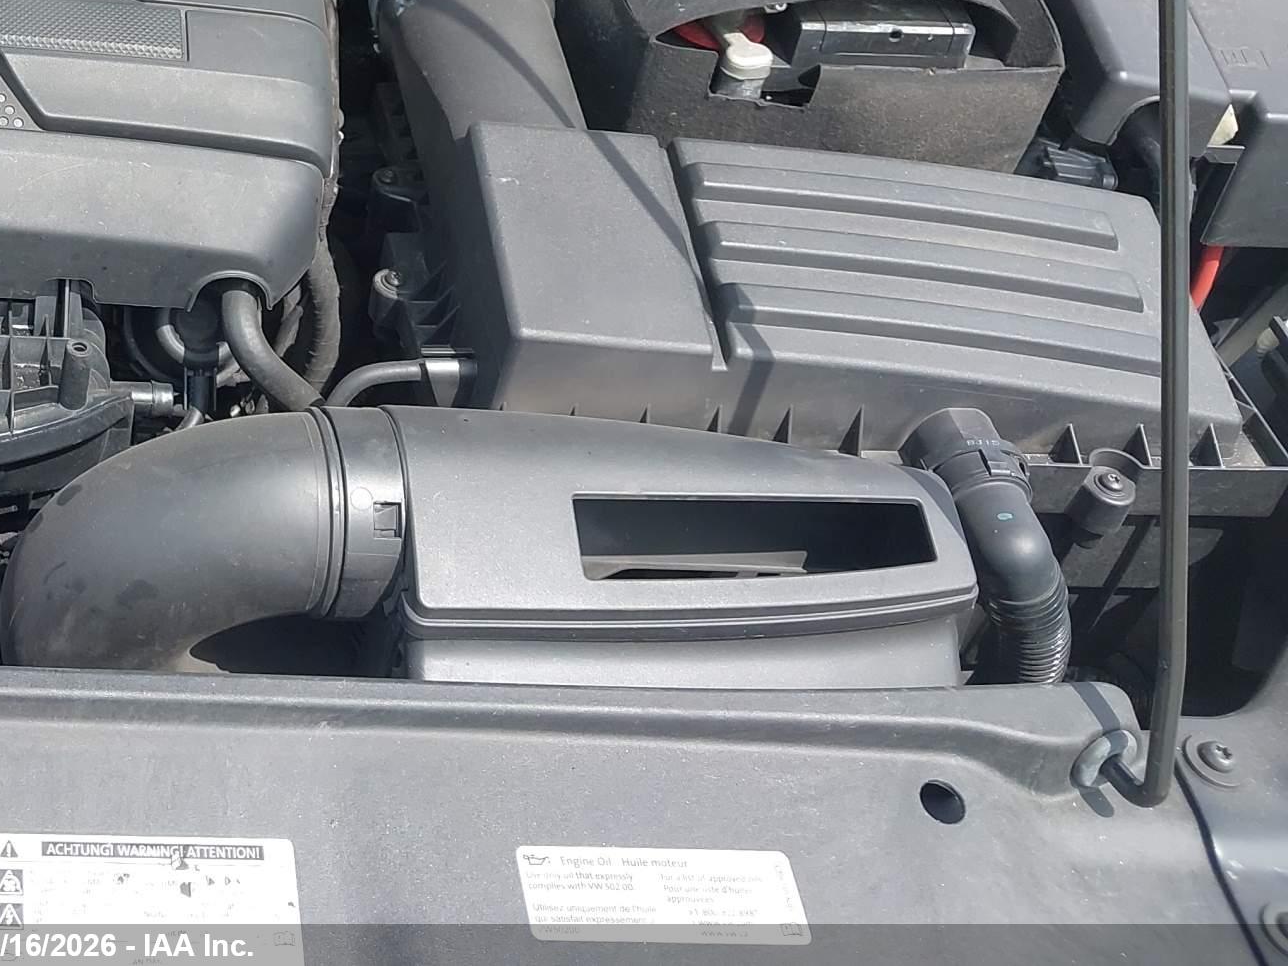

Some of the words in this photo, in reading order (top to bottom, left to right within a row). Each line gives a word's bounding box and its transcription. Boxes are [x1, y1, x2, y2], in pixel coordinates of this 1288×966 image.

[46, 842, 114, 857] ACHTUNG!
[118, 843, 184, 858] WARNING!
[187, 845, 261, 859] ATTENTION!
[560, 856, 595, 868] Engine
[621, 858, 649, 867] Huile
[651, 859, 688, 868] moteur
[575, 872, 593, 880] that
[528, 882, 565, 892] complies
